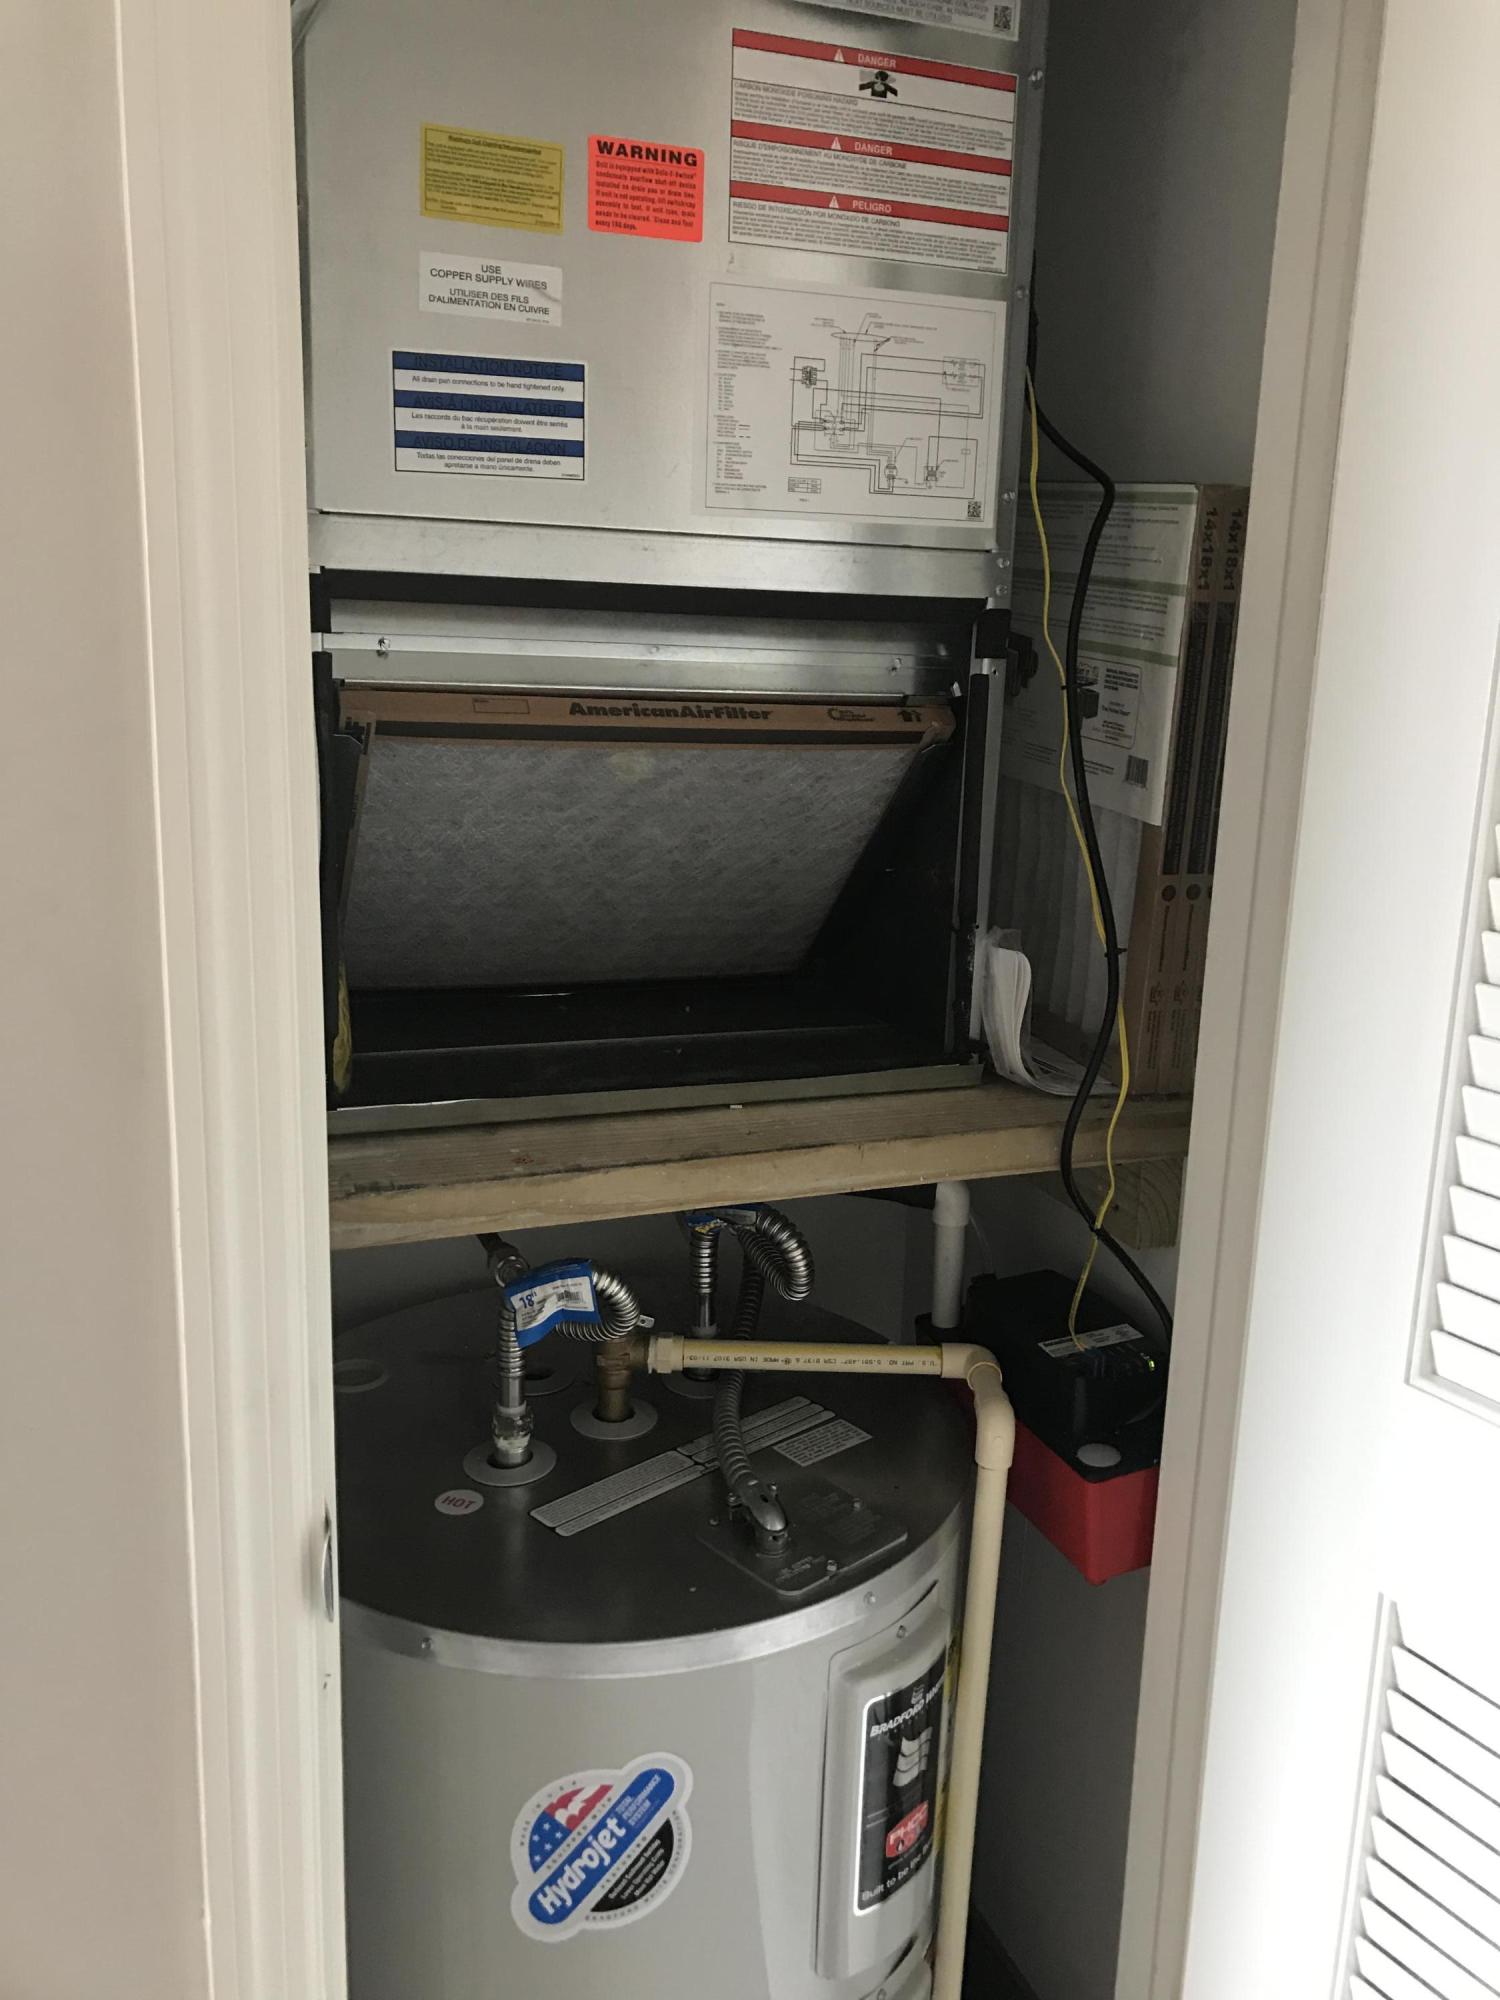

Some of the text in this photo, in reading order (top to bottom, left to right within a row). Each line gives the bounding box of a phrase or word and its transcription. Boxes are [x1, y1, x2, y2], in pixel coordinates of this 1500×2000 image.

[858, 53, 896, 68] DANGER
[597, 140, 697, 167] WARNING
[854, 142, 893, 155] DANGER
[852, 200, 891, 213] PELIGRO
[481, 264, 502, 275] USE
[430, 268, 547, 290] COPPER SUPPLY WIRES
[428, 294, 550, 315] D'ALIMENTATION EN CUIVRE
[450, 288, 529, 304] UTILISER DES FILS
[414, 435, 453, 448] AVISO
[457, 438, 476, 449] DE
[1223, 508, 1243, 591] 14x18x1
[569, 702, 772, 720] AmericanAirFilter
[441, 1496, 476, 1509] HOT
[870, 1699, 924, 1737] BRADFORD
[536, 1816, 626, 1915] Hydrojet
[862, 1884, 885, 1901] Built
[886, 1876, 896, 1888] to
[898, 1866, 909, 1880] be
